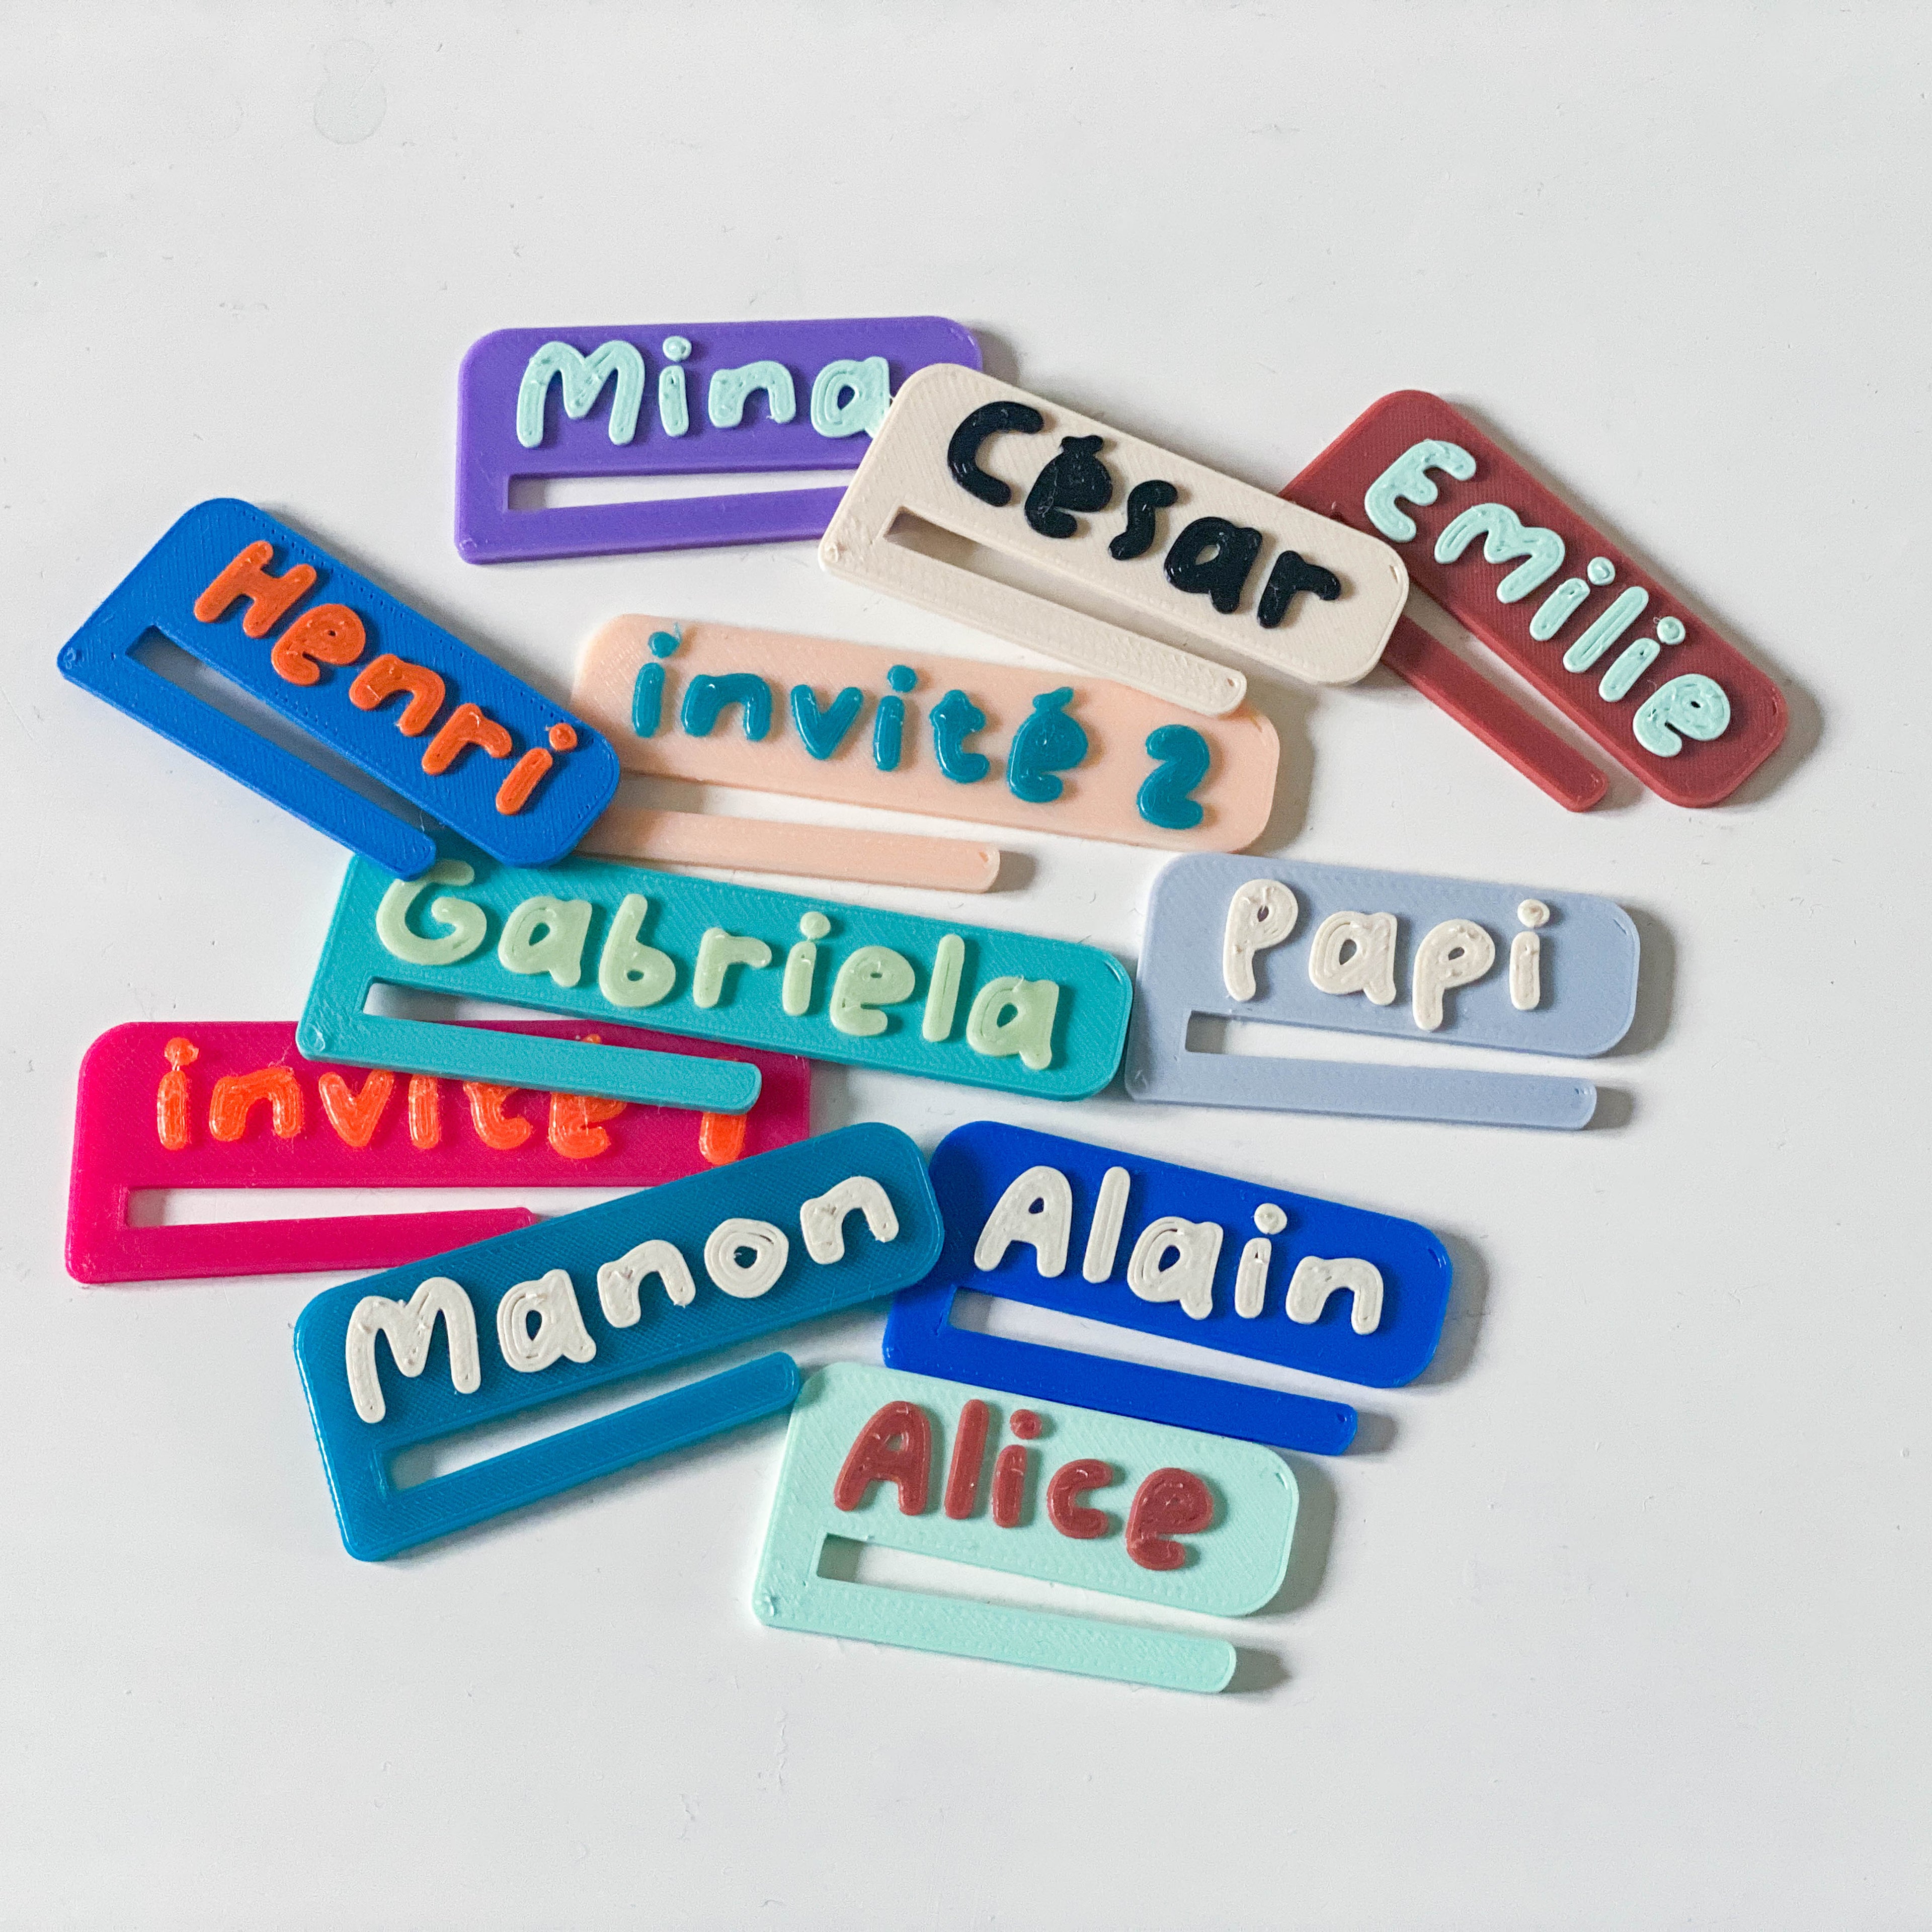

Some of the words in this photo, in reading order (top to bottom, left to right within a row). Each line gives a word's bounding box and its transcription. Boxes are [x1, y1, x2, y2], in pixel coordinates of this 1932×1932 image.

[517, 336, 891, 447] Mina
[948, 401, 1341, 627] César
[1365, 439, 1730, 757] Emilie
[194, 540, 578, 815] Henri
[631, 631, 1087, 802] invité
[1137, 725, 1210, 829] 2
[376, 860, 1059, 1070] Gabriela
[1223, 879, 1550, 1031] Papi
[346, 1176, 899, 1423] Manon
[975, 1166, 1384, 1335] Alain
[834, 1399, 1214, 1570] Alice
